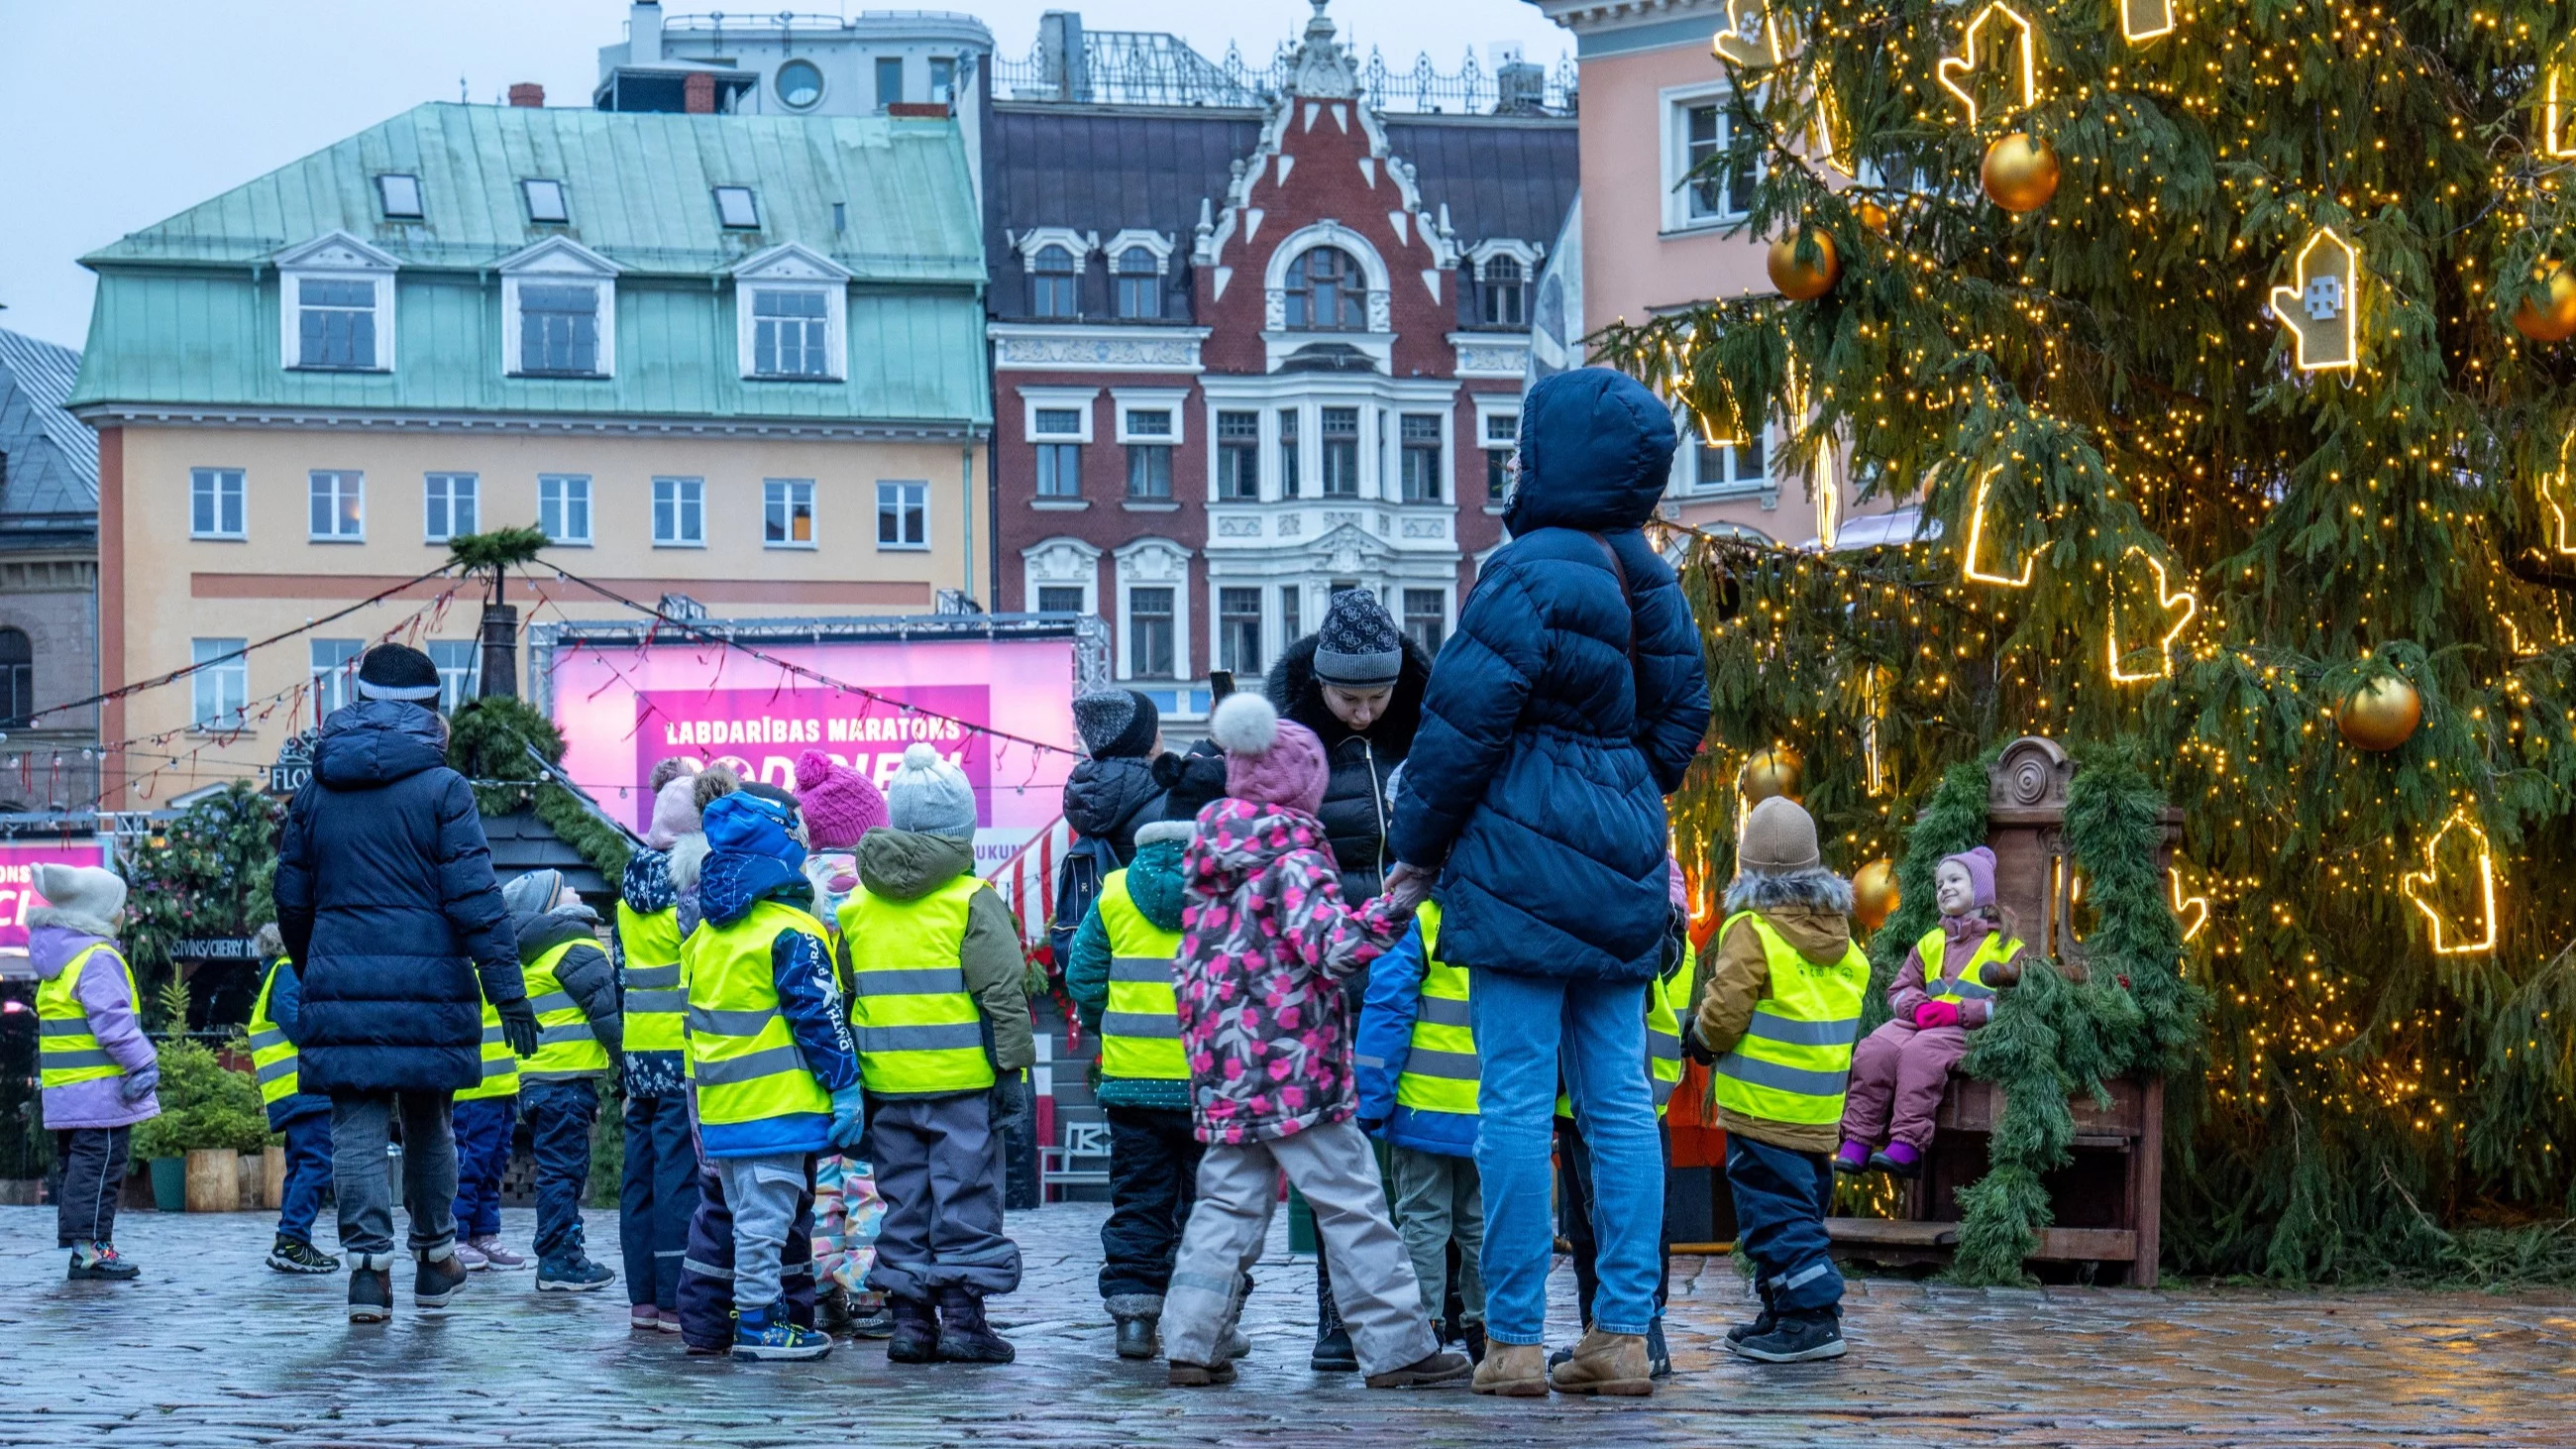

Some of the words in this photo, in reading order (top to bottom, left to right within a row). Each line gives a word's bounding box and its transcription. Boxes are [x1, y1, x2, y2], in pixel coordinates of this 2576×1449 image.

[666, 716, 820, 745] LABDARĪBAS
[827, 717, 961, 742] MARATONS
[271, 768, 312, 791] FLO
